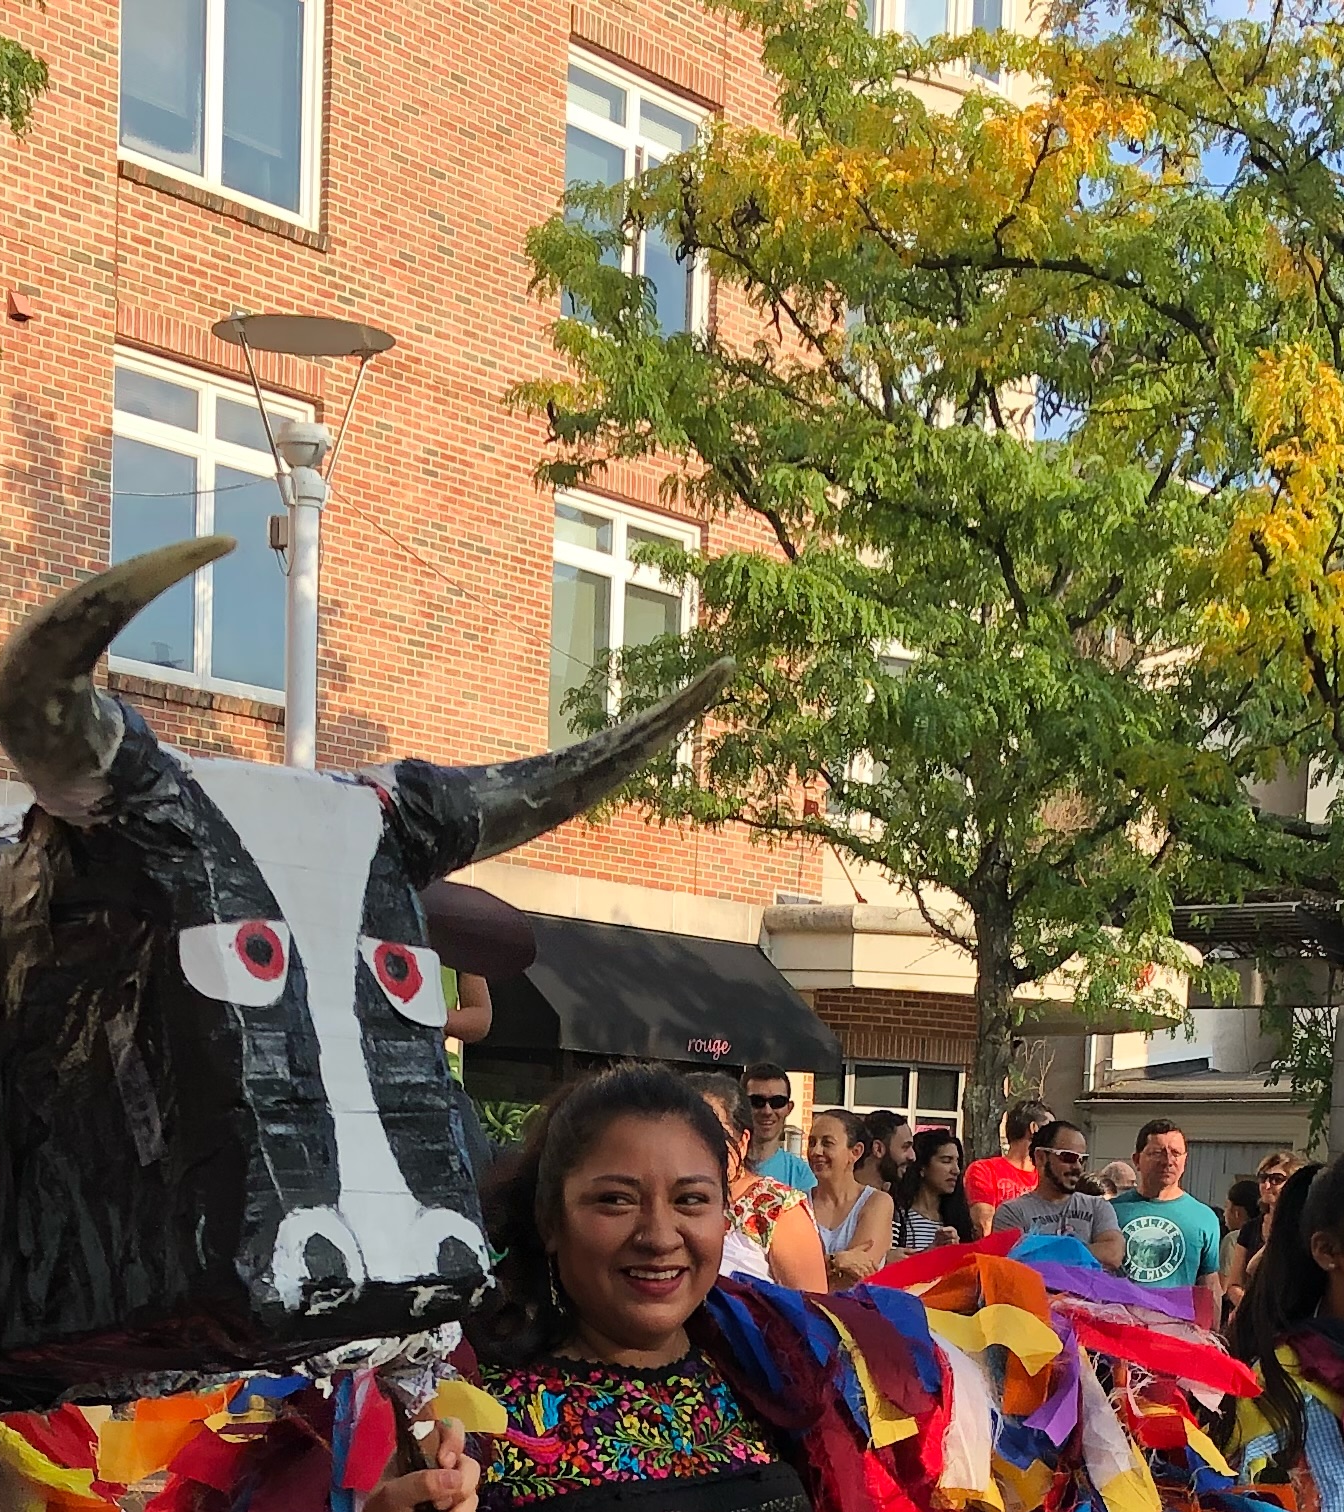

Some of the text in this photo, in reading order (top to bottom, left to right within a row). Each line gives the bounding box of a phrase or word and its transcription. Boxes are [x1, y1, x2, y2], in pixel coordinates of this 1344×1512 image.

[687, 1038, 732, 1061] rouge
[1125, 1218, 1180, 1238] EXPLORE
[1146, 1261, 1175, 1281] WILD
